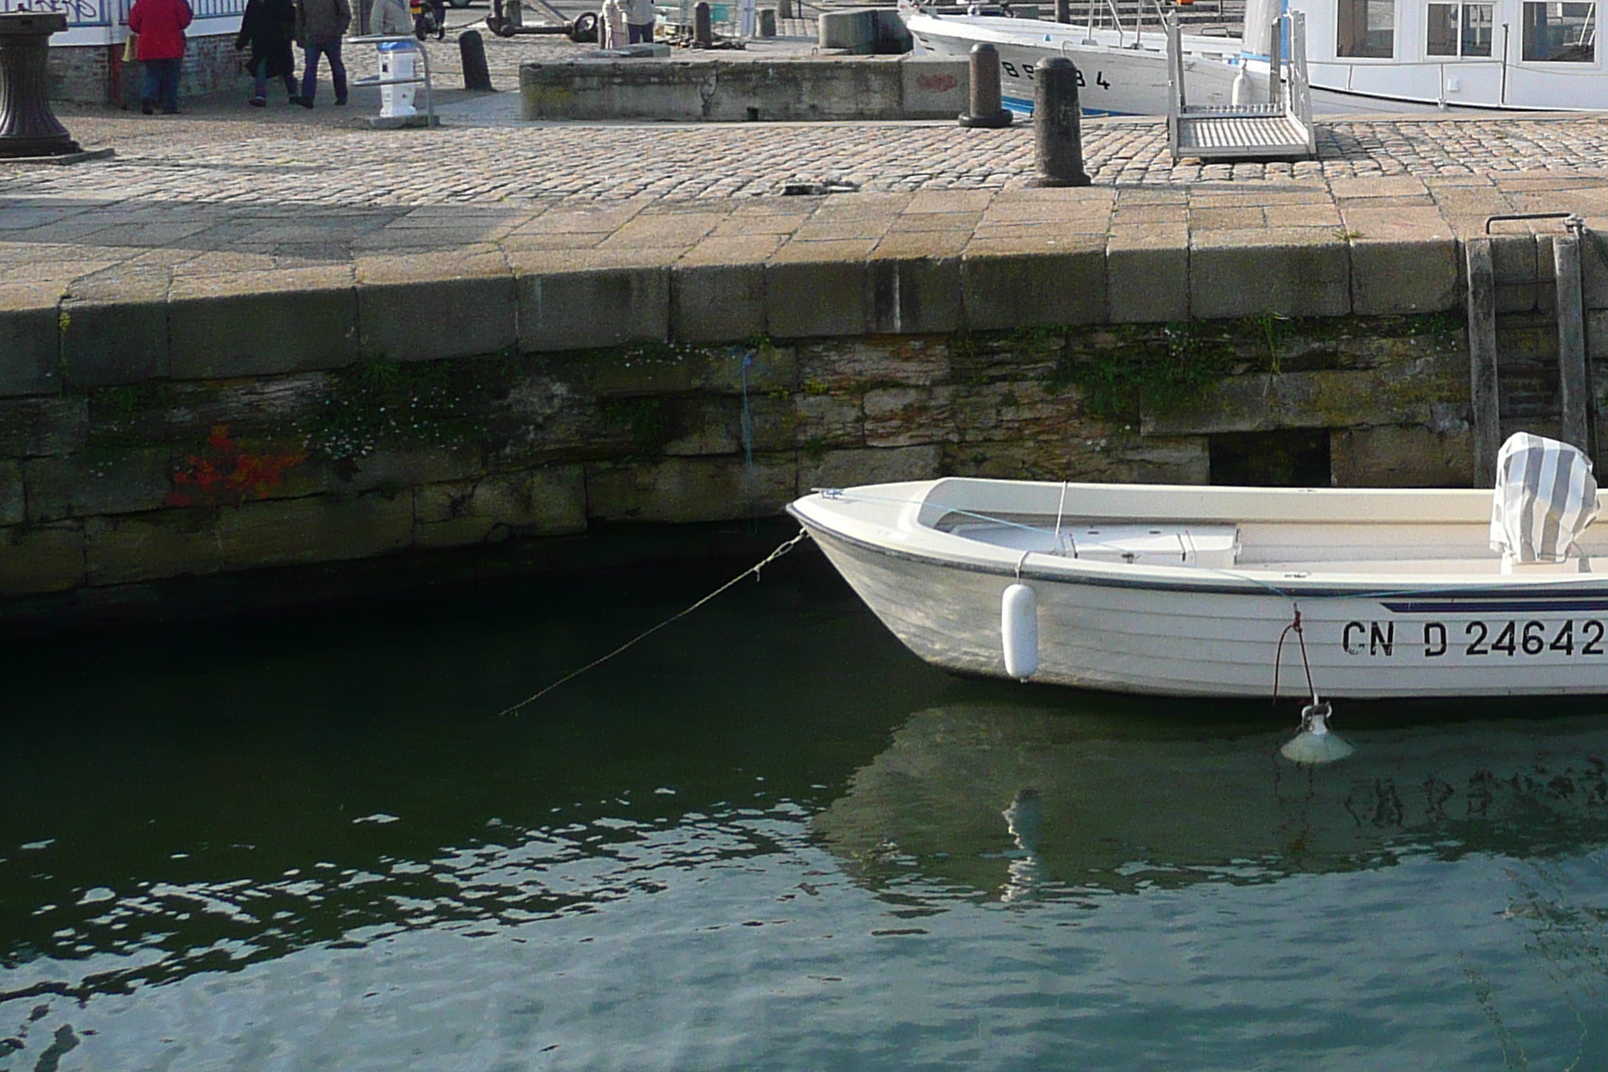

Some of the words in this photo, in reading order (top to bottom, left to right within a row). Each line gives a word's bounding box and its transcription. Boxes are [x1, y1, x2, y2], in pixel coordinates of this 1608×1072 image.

[1342, 620, 1394, 657] CN
[1424, 621, 1448, 658] D
[1465, 618, 1606, 657] 24642
